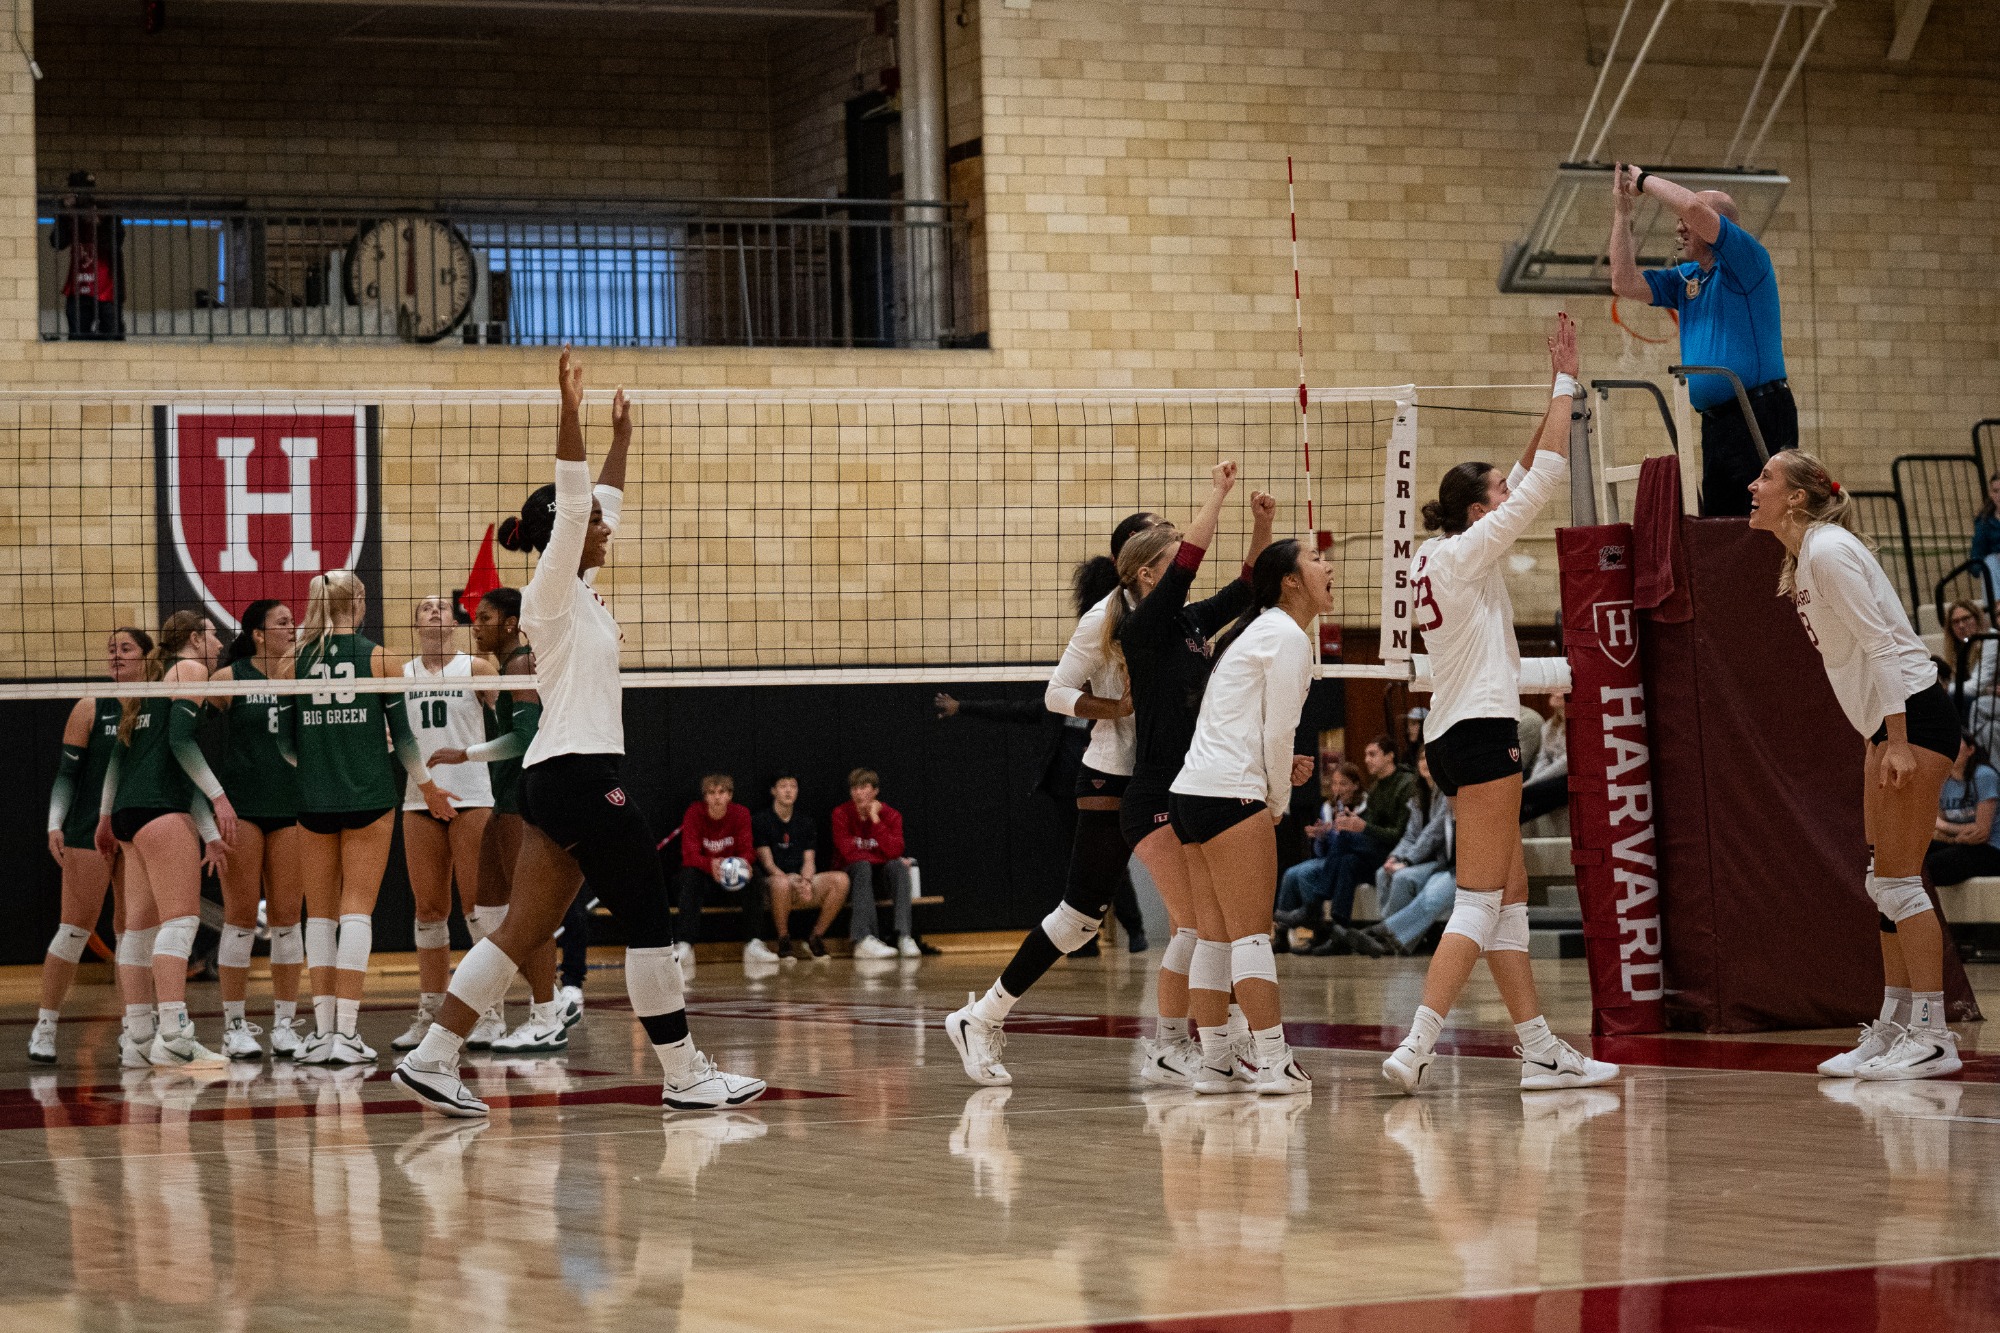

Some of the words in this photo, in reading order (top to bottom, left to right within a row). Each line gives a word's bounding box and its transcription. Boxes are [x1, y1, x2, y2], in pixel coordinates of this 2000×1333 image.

[216, 436, 319, 572] H
[1391, 449, 1412, 650] CRIMSON
[1605, 609, 1634, 647] H
[302, 709, 322, 726] BIG
[326, 708, 368, 724] GREEN
[420, 700, 448, 728] 10
[609, 790, 624, 803] H
[1600, 682, 1665, 1001] HARVARD
